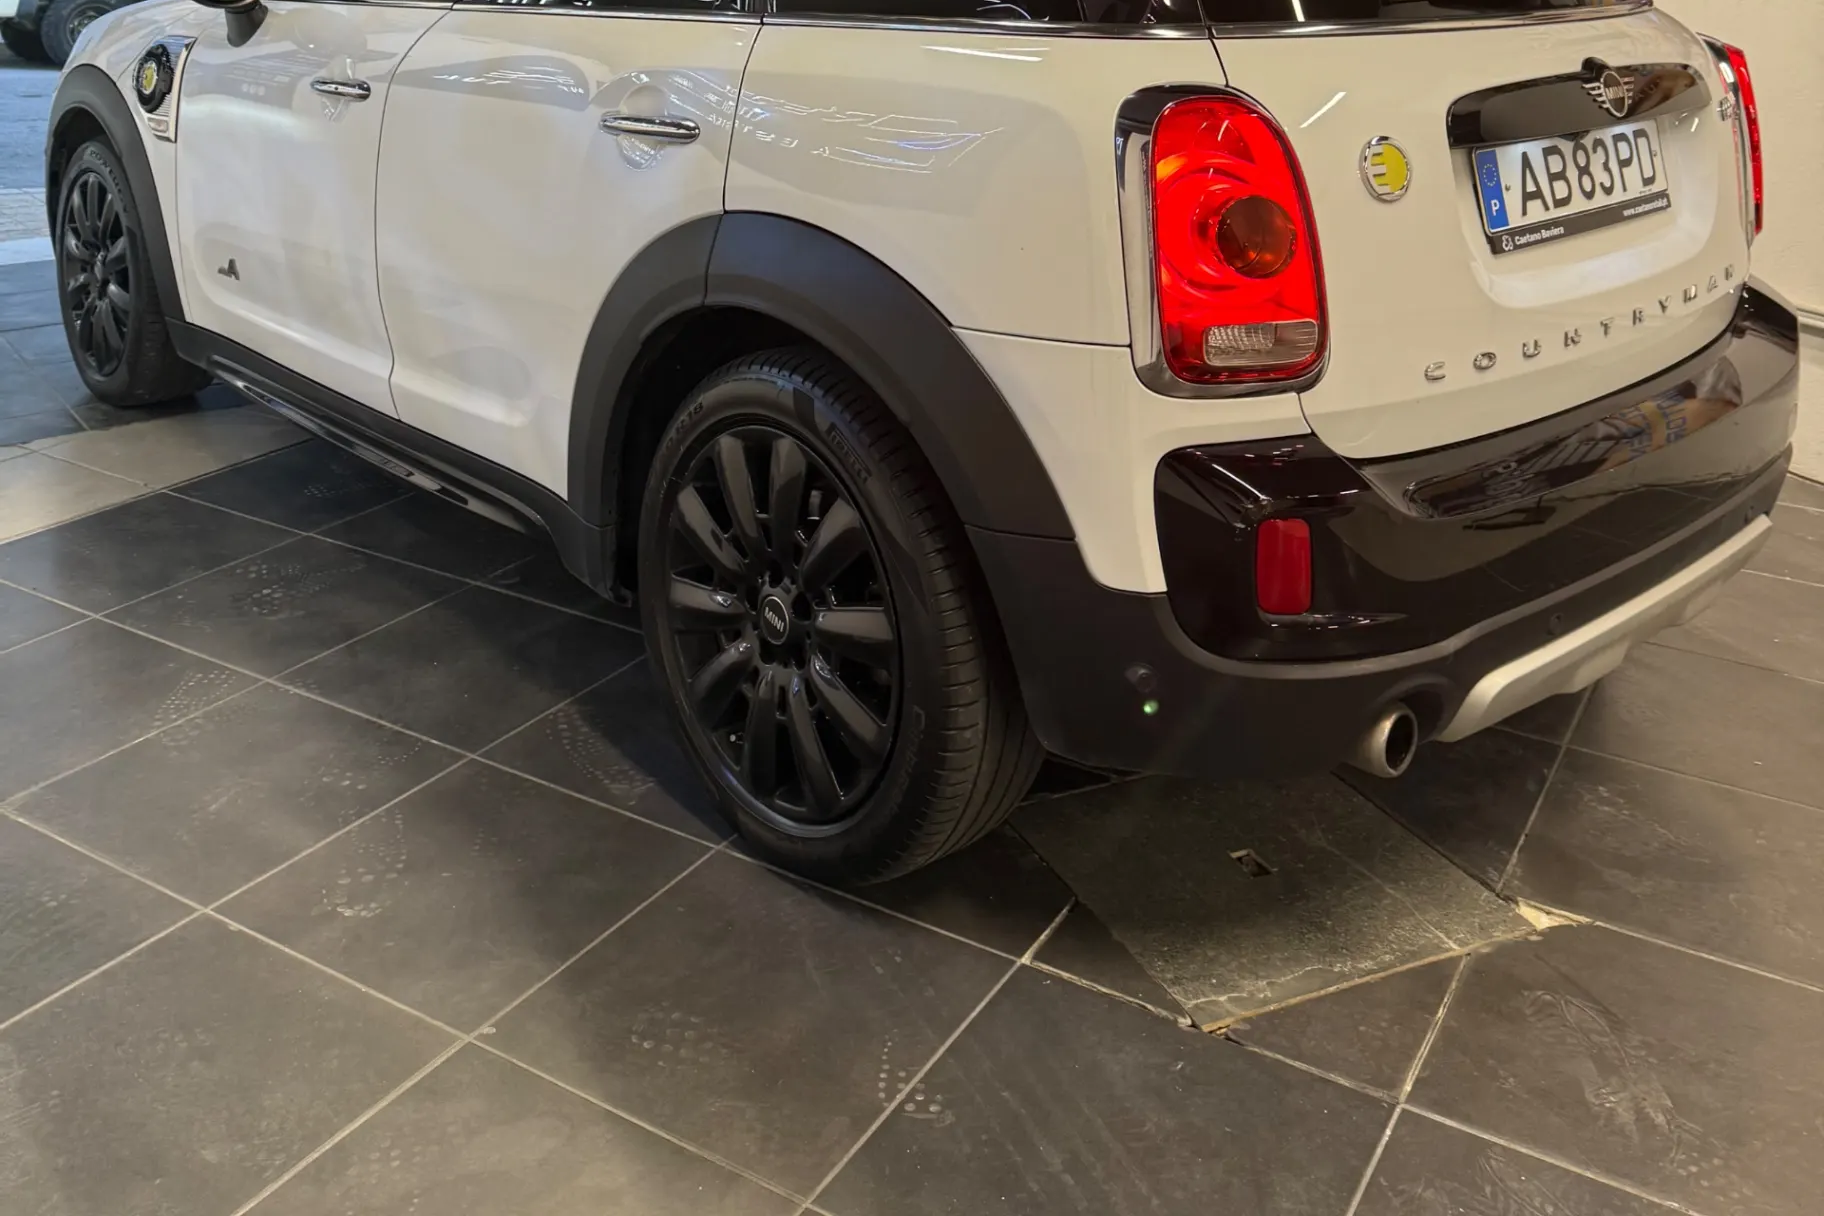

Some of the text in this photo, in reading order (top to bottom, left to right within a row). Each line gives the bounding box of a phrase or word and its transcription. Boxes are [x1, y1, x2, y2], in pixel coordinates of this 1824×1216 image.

[1605, 85, 1626, 100] MINI
[1490, 199, 1500, 217] P
[1514, 226, 1565, 245] Caetano Baviera
[1423, 264, 1735, 382] COUNTRYMAN
[764, 606, 785, 633] MINI
